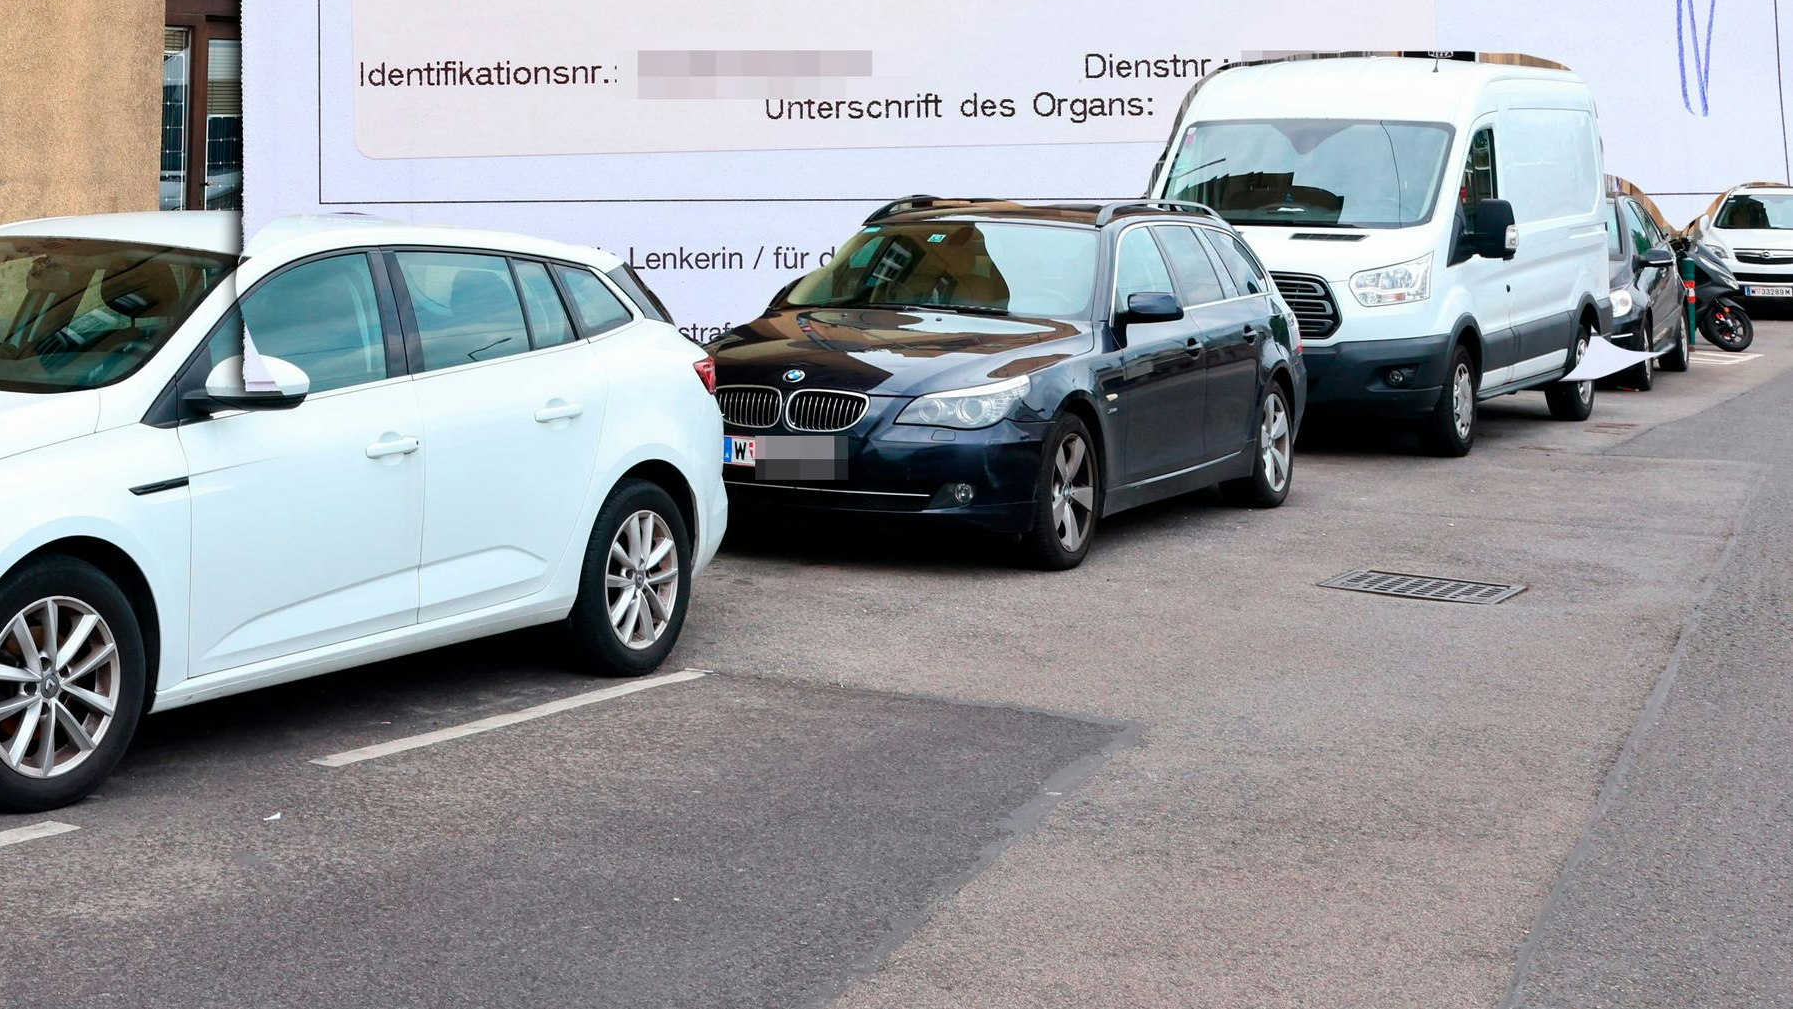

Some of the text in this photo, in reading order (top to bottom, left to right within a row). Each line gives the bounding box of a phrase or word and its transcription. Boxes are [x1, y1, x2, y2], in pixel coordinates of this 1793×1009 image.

[360, 60, 618, 88] Identifikationsnr.:
[765, 91, 1154, 124] Unterschrift des Organs:
[629, 247, 743, 270] Lenkerin
[773, 246, 810, 270] für
